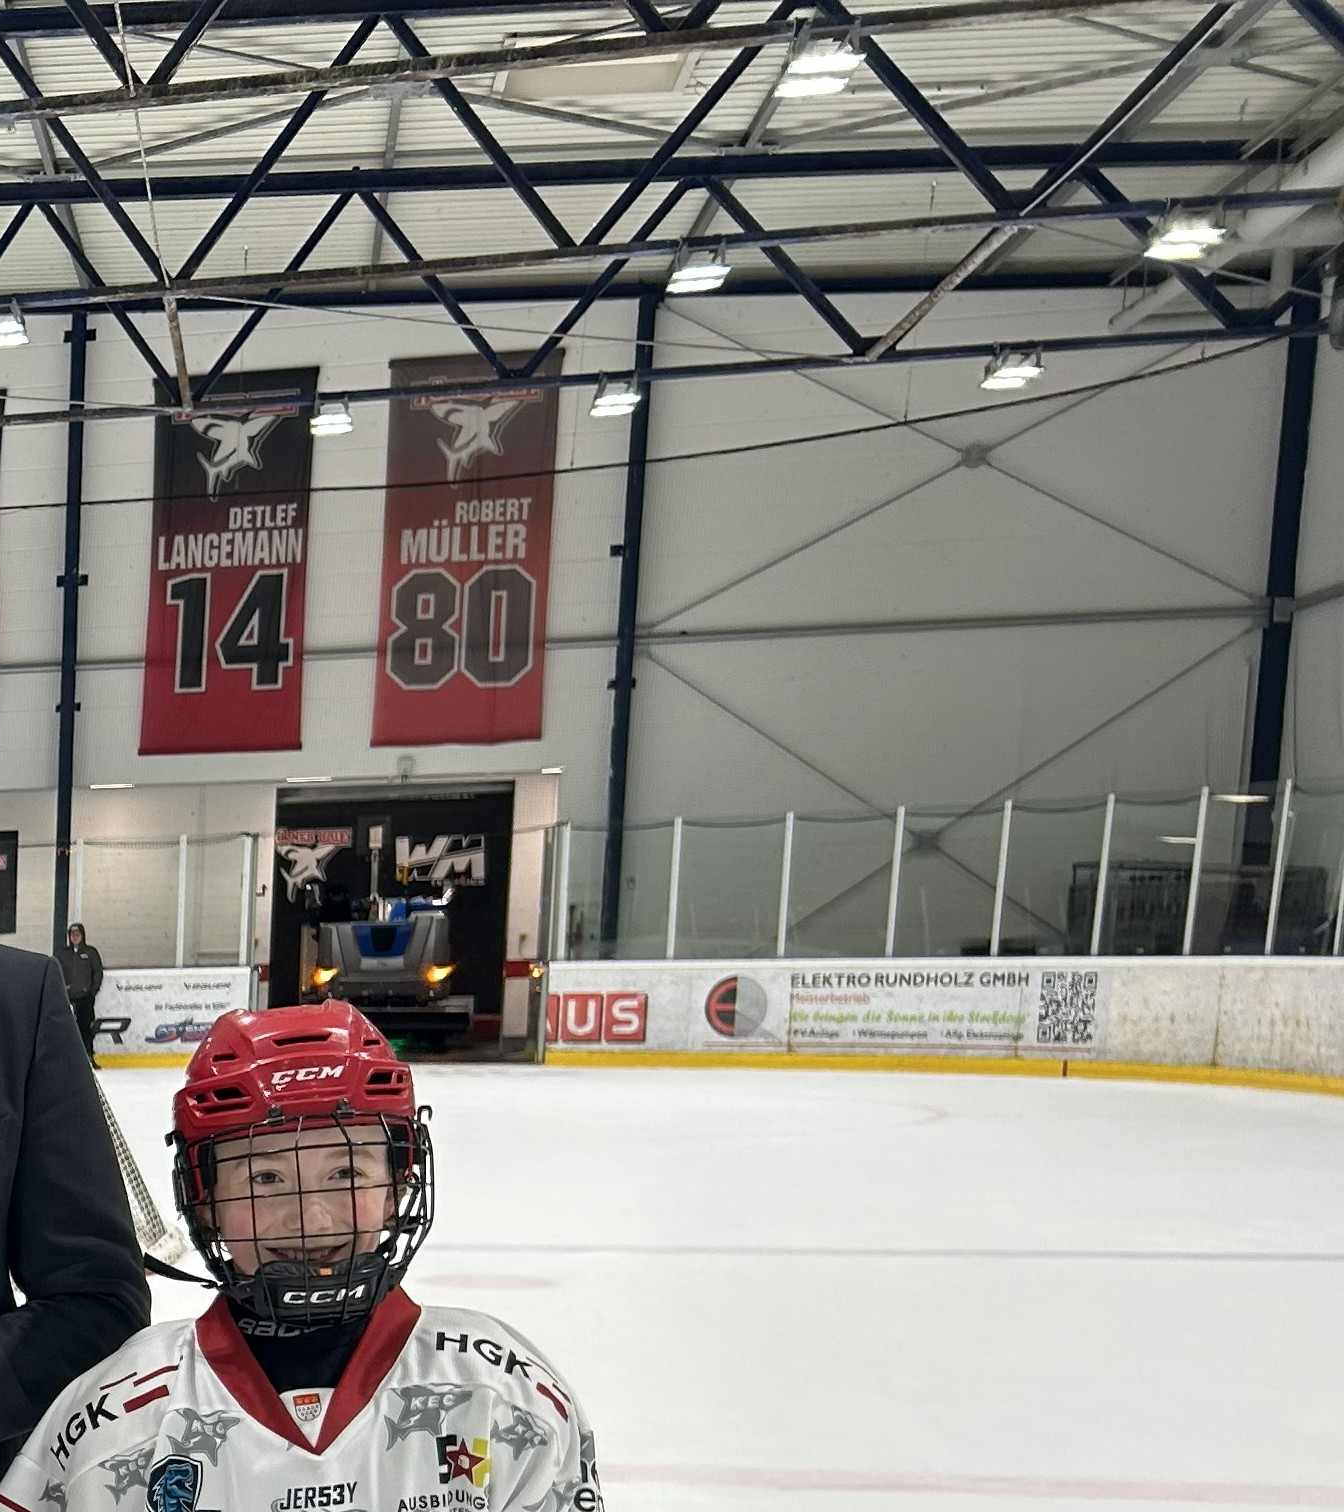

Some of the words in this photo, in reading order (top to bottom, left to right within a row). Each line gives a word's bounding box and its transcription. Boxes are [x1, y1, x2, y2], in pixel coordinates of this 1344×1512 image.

[228, 503, 297, 530] DETLEF
[455, 498, 532, 524] ROBERT
[158, 528, 303, 571] LANGEMANN
[400, 519, 526, 565] MÜLLER
[166, 567, 293, 693] 14
[386, 564, 536, 690] 80
[791, 972, 870, 988] ELEKTRO
[874, 972, 974, 988] RUNDHOLZ
[979, 971, 1029, 987] GMBH
[271, 1065, 344, 1085] CCM
[282, 1285, 365, 1305] CCM
[435, 1331, 534, 1382] HGK
[50, 1392, 119, 1472] HGK
